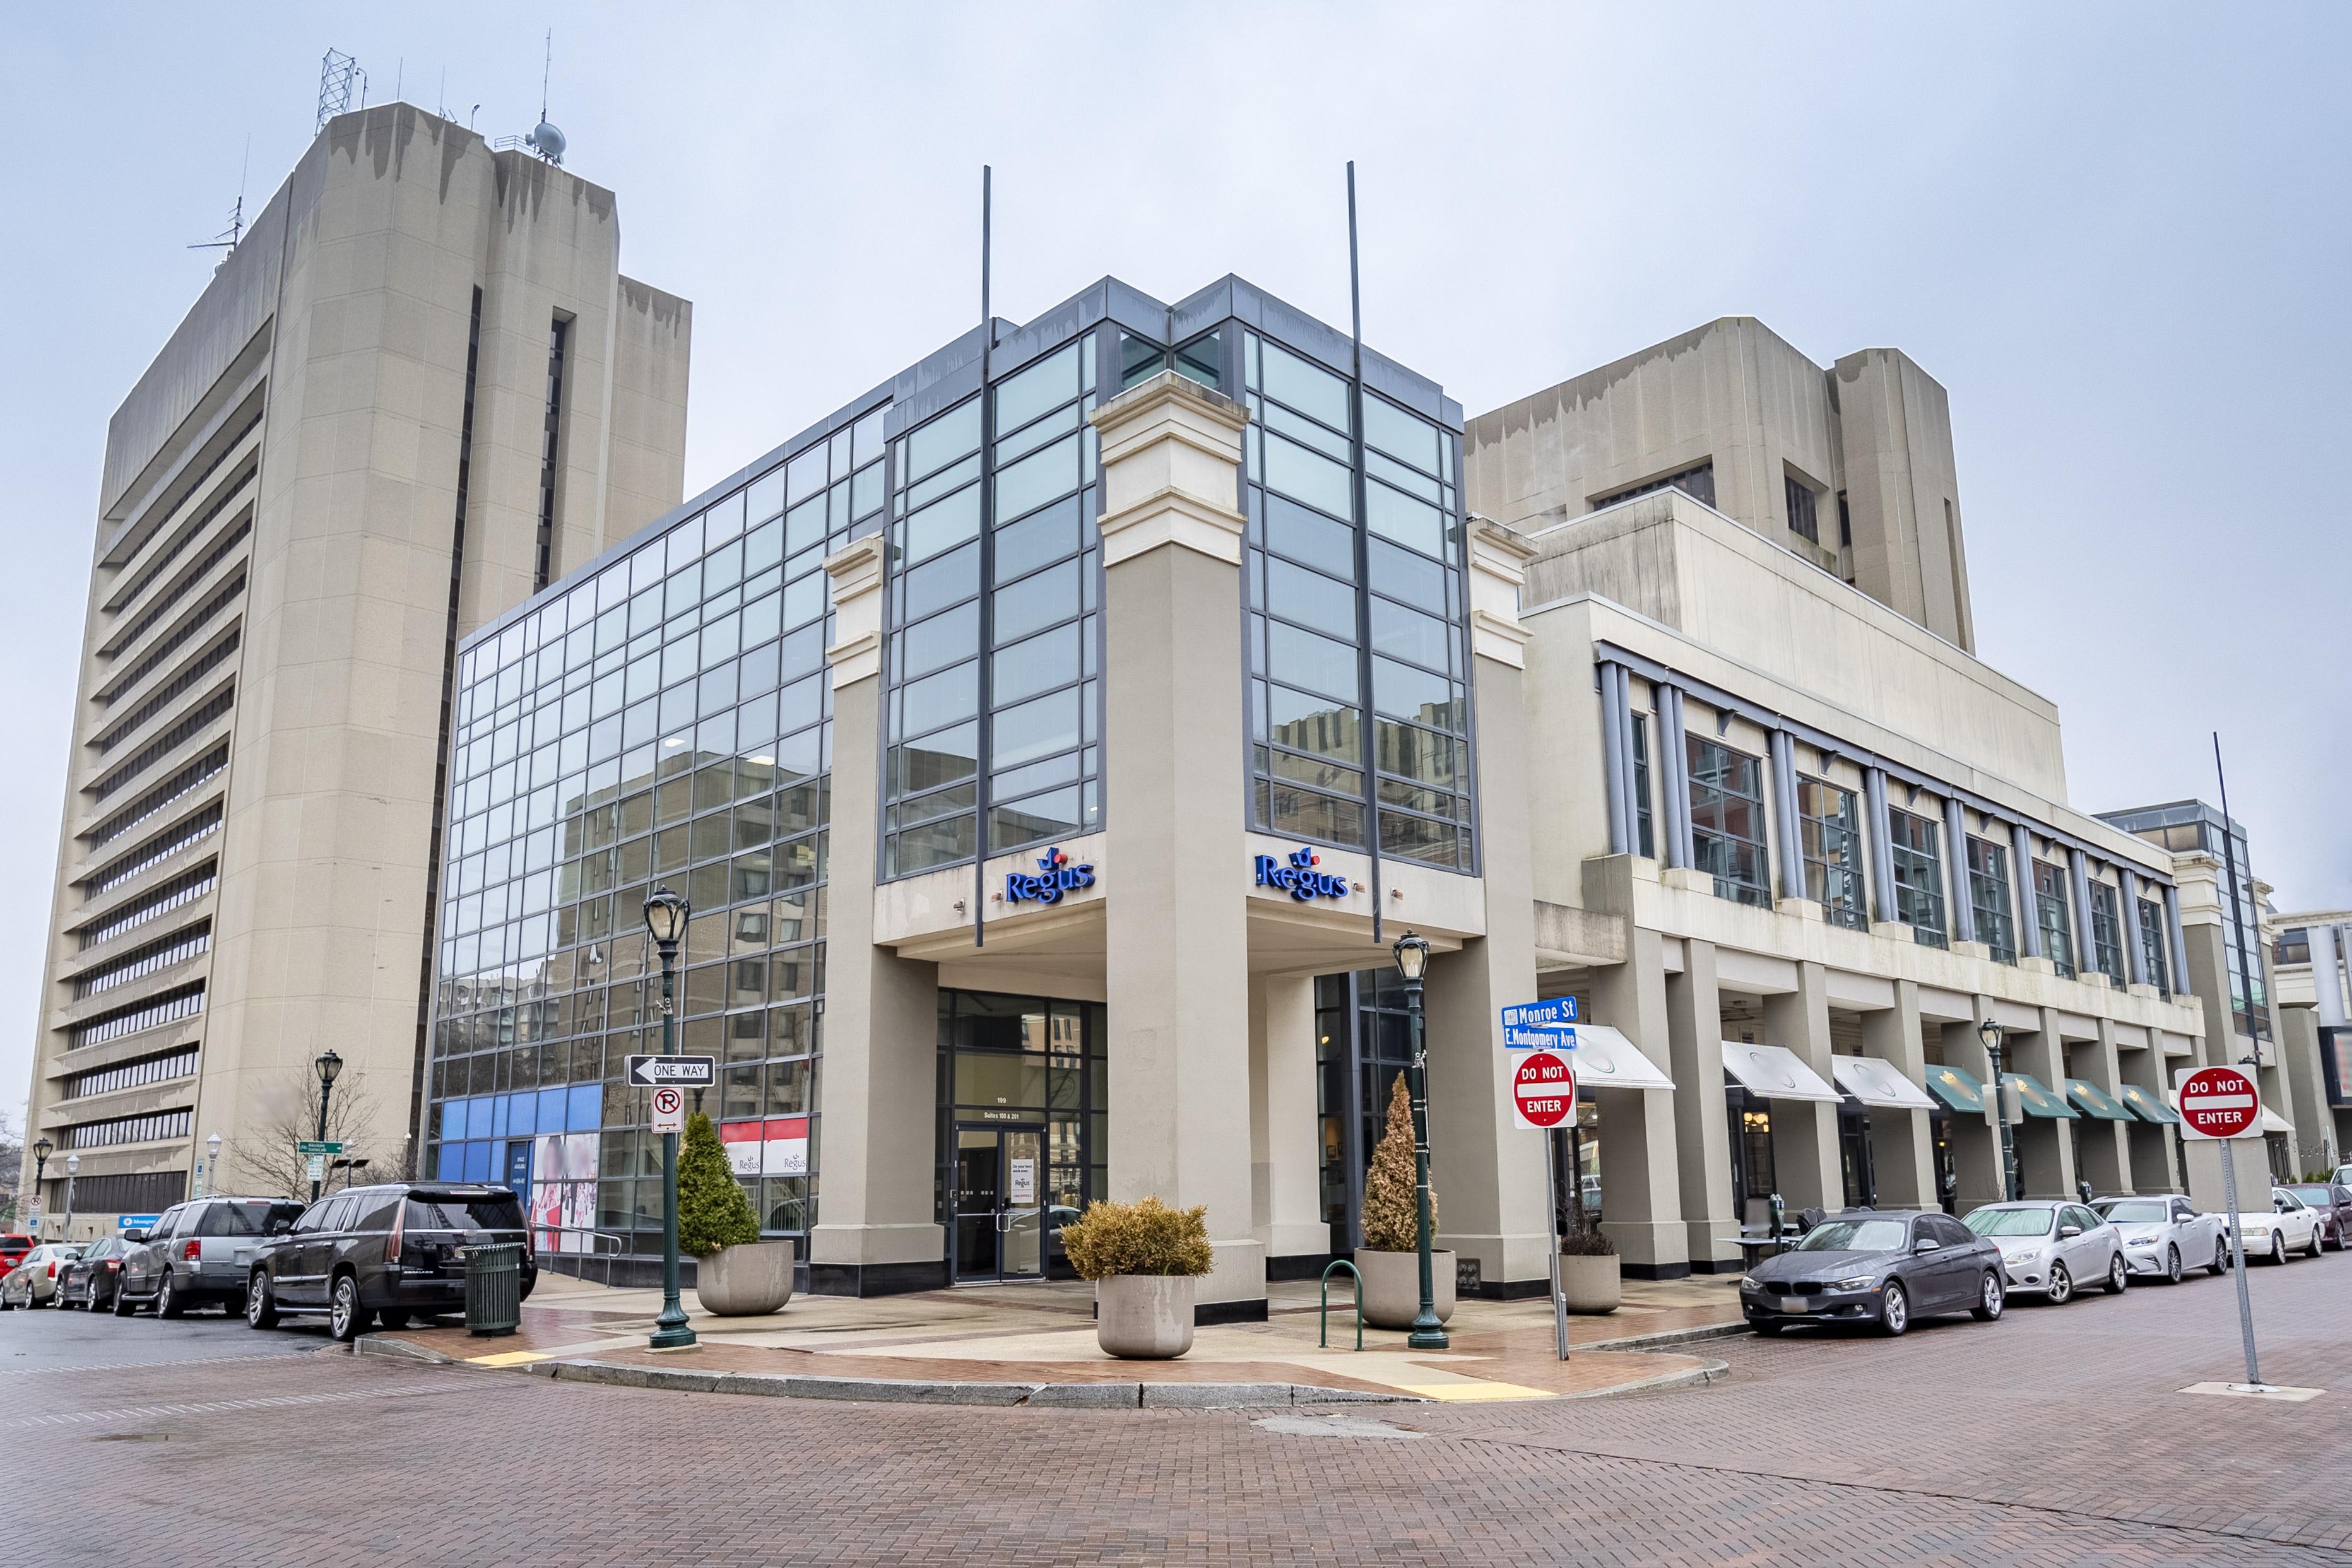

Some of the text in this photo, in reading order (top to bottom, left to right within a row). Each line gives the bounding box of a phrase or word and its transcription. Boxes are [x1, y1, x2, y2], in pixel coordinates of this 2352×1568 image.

[1006, 864, 1096, 904] Regus
[1255, 855, 1348, 901] Regus
[1519, 1000, 1575, 1024] Monroe St
[1561, 1030, 1575, 1047] Ave
[654, 1065, 705, 1076] ONE WAY
[1522, 1066, 1564, 1080] DO NOT
[2189, 1080, 2244, 1093] DO NOT
[1527, 1100, 1562, 1112] ENTER
[2197, 1111, 2242, 1124] ENTER
[739, 1160, 759, 1172] Regus
[784, 1158, 806, 1170] Regus
[1015, 1180, 1030, 1188] Regus
